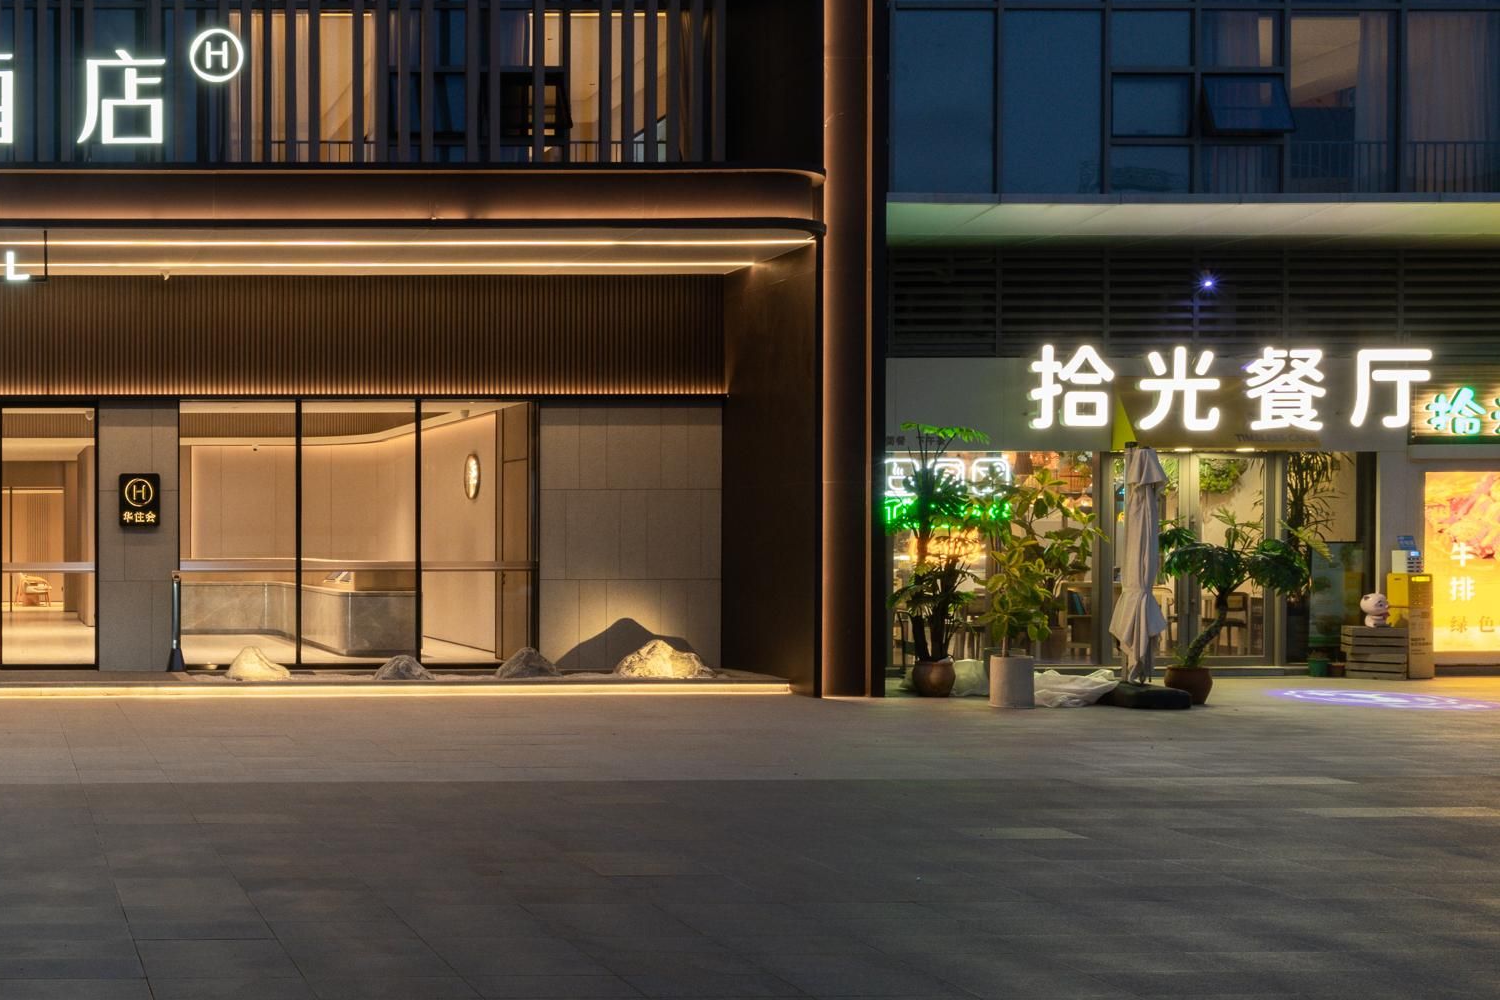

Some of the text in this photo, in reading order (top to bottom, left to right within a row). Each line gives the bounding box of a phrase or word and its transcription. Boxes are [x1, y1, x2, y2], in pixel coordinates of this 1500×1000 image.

[1030, 344, 1433, 431] 拾光餐厅
[1426, 386, 1500, 435] 拾
[123, 511, 156, 523] 华住会
[1450, 542, 1476, 601] 牛排
